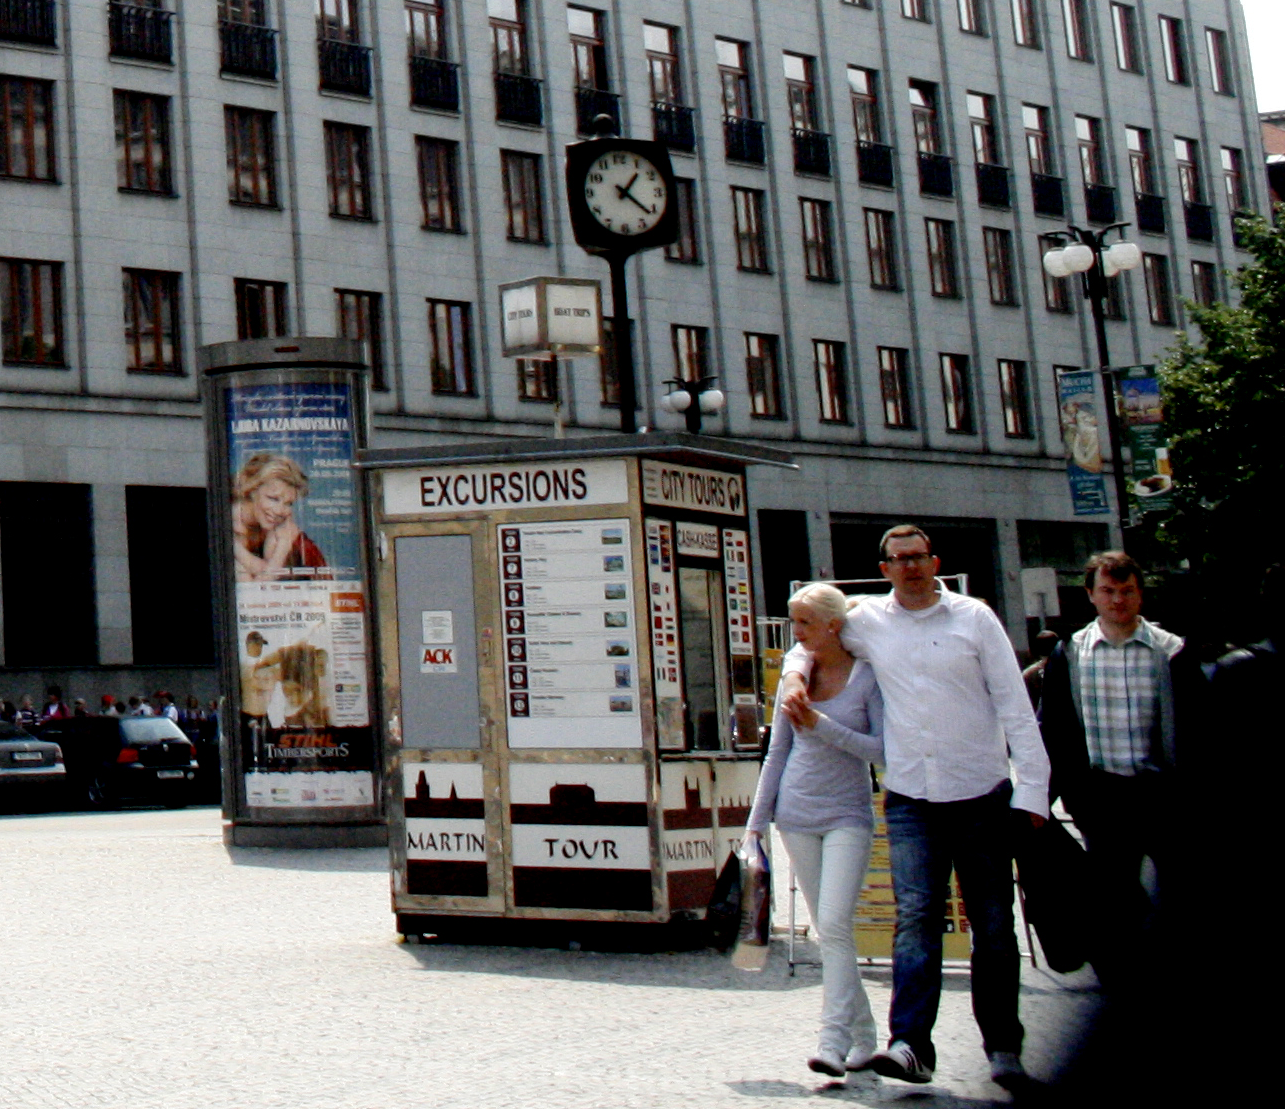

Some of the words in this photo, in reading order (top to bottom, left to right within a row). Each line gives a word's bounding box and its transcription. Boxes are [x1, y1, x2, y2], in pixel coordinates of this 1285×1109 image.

[420, 468, 588, 507] EXCURSIONS
[661, 469, 685, 502] CITY
[687, 472, 725, 507] TOURS
[407, 832, 485, 852] MARTIN
[543, 838, 619, 860] TOUR
[662, 840, 713, 860] MARTIN
